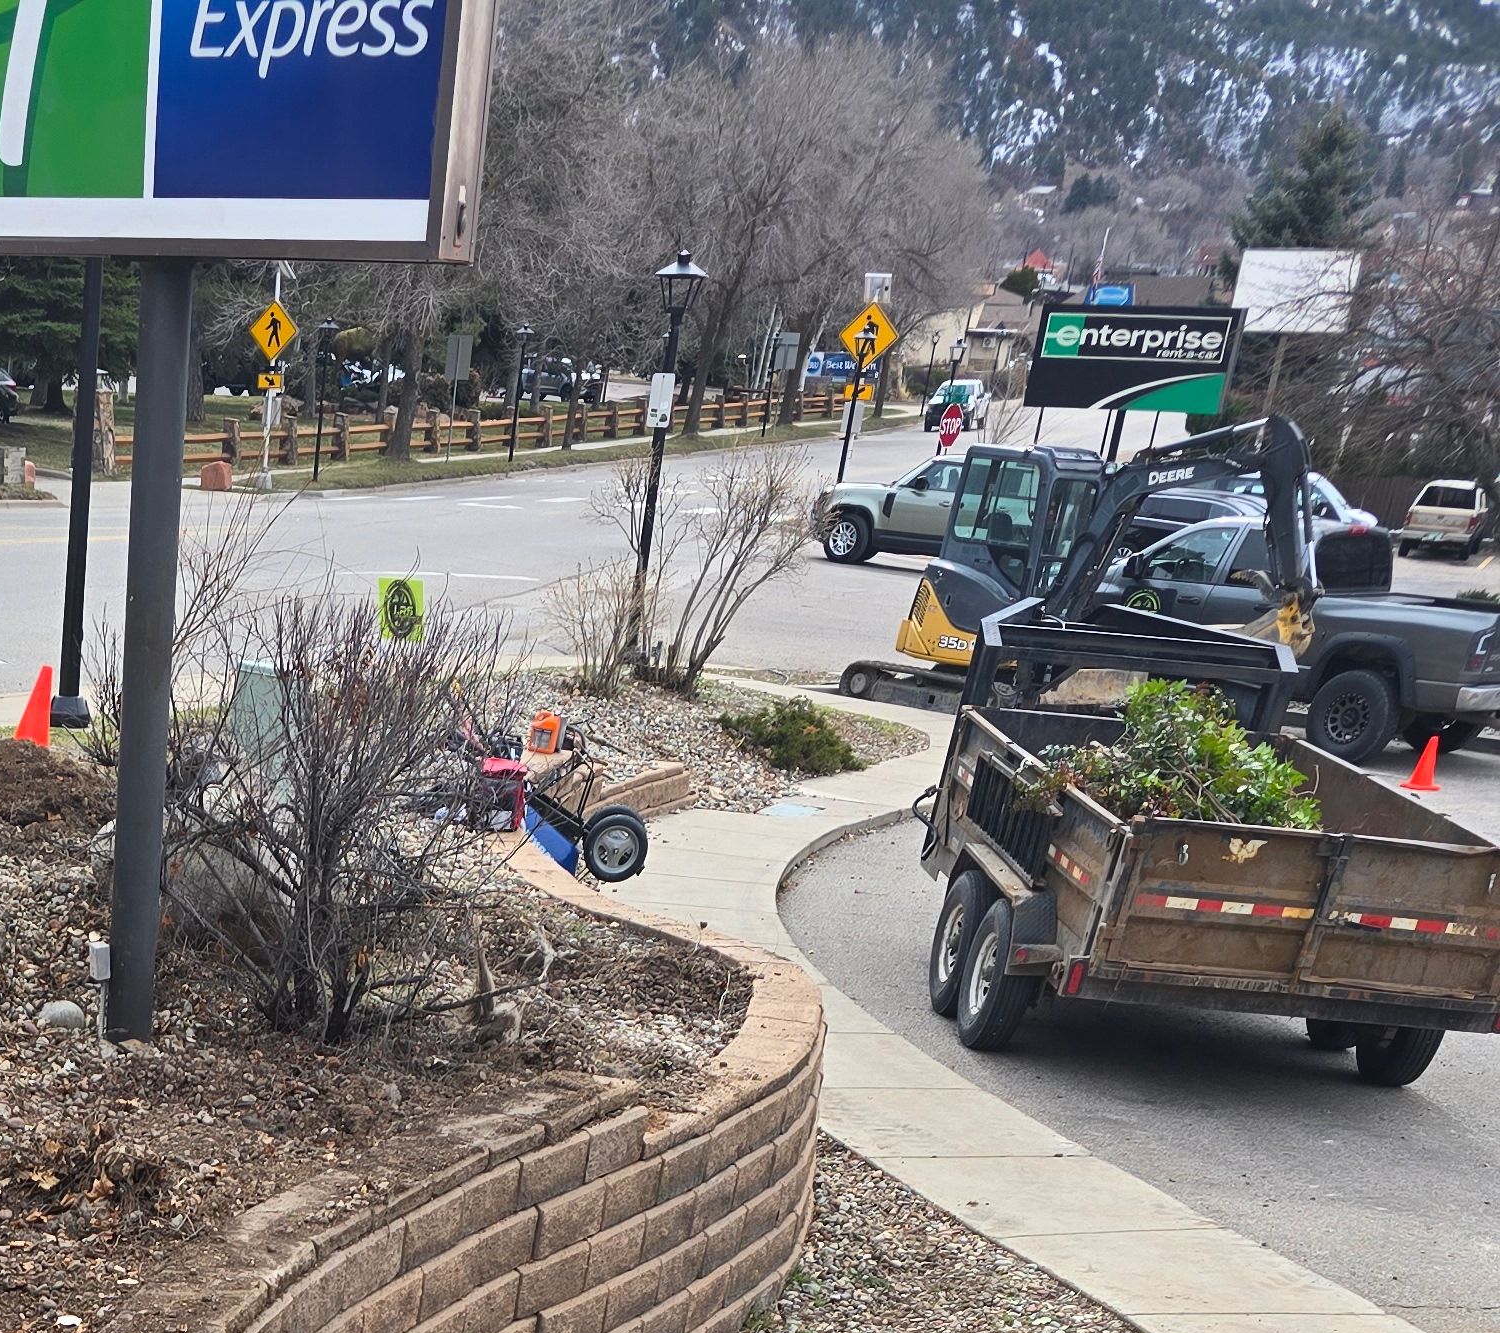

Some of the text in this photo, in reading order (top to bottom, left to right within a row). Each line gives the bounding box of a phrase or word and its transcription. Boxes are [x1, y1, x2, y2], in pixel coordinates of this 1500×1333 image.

[190, 0, 434, 79] Express
[1054, 324, 1224, 353] enterprise
[1156, 348, 1220, 360] rent-a-car
[826, 360, 843, 370] Best
[941, 417, 962, 435] STOP
[1148, 466, 1195, 486] DEERE
[938, 635, 968, 650] 35D
